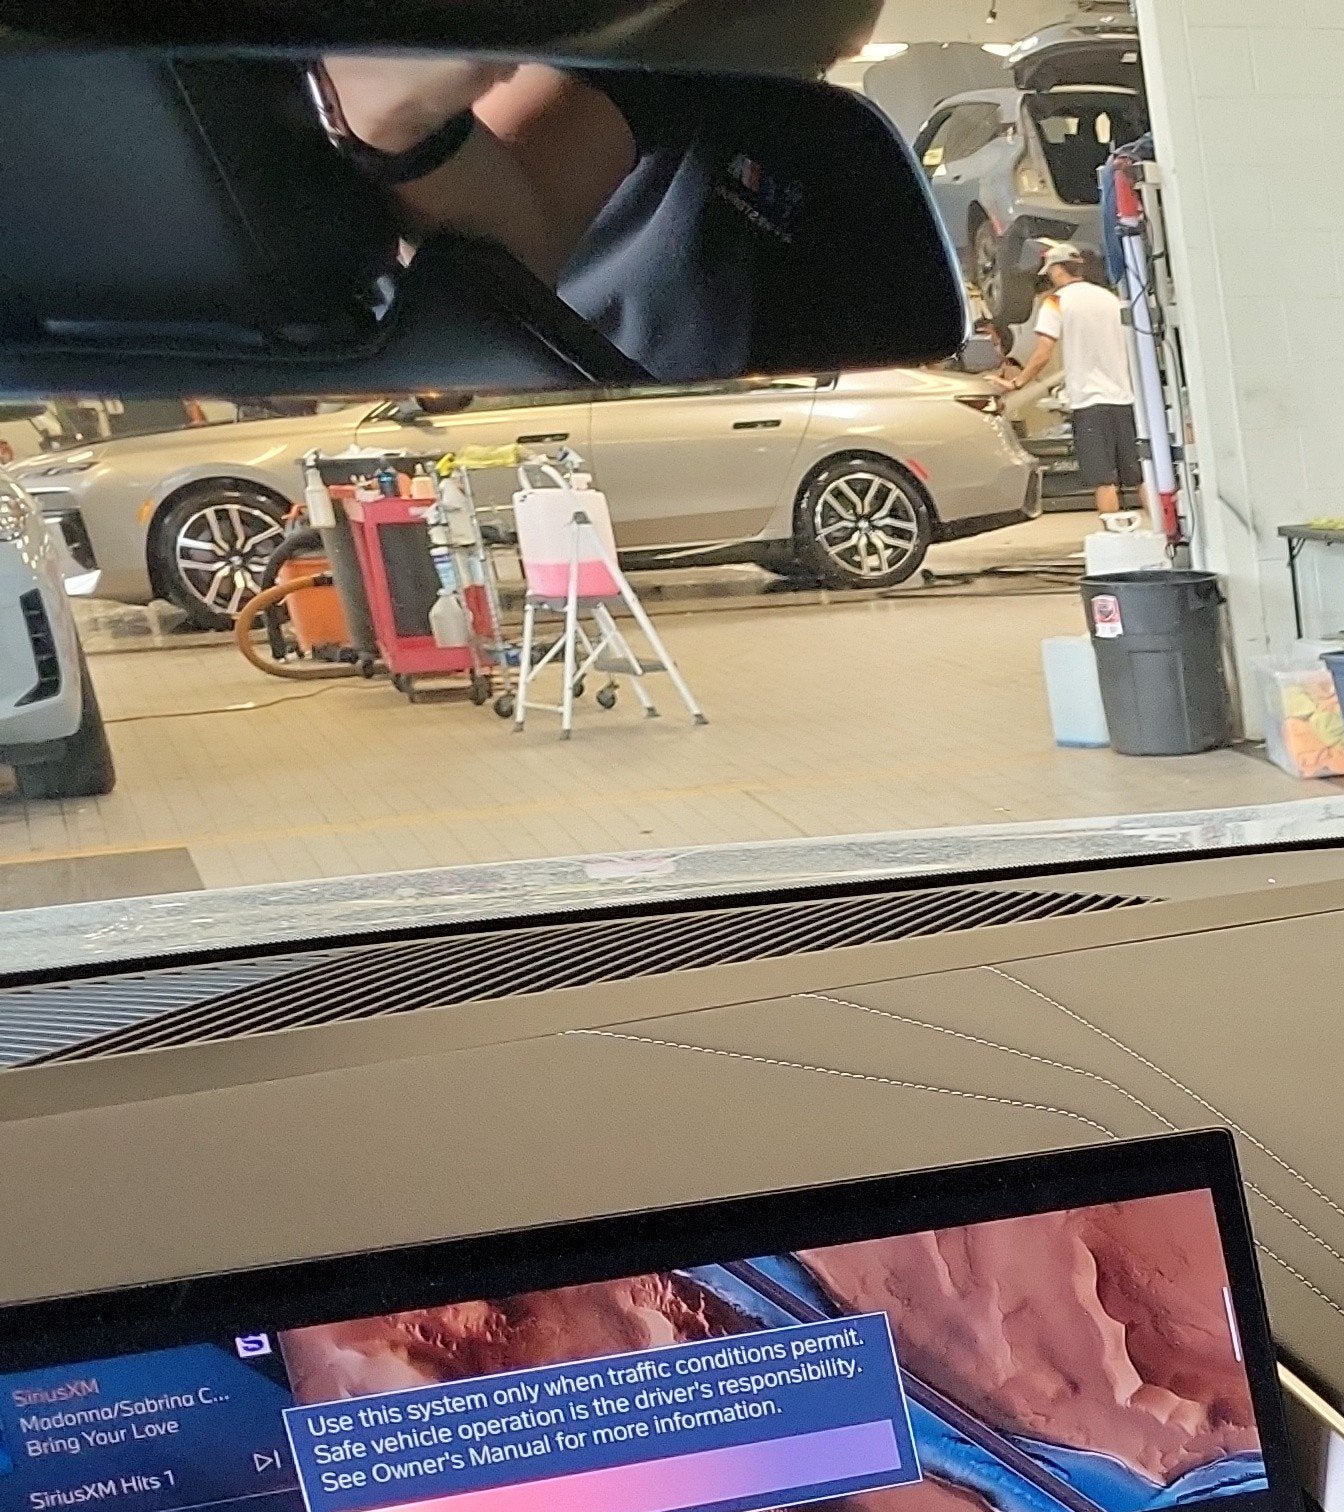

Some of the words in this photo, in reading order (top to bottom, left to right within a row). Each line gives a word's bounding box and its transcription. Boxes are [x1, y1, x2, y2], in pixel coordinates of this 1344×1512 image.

[12, 1378, 100, 1407] SiriusXM
[307, 1414, 353, 1437] Use
[358, 1404, 402, 1429] this
[406, 1391, 488, 1423] system
[493, 1381, 540, 1406] only
[543, 1373, 604, 1397] when
[607, 1361, 671, 1387] traffic
[675, 1343, 787, 1376] conditions
[790, 1327, 864, 1359] permit.
[20, 1391, 195, 1434] Madonna/Sabrina
[198, 1387, 230, 1405] C...
[313, 1441, 367, 1465] Safe
[371, 1423, 453, 1455] vehicle
[458, 1407, 565, 1442] operation
[569, 1401, 590, 1422] is
[592, 1394, 630, 1418] the
[634, 1380, 714, 1410] driver's
[718, 1357, 863, 1397] responsibility.
[26, 1435, 81, 1458] Bring
[82, 1427, 127, 1448] Your
[131, 1419, 180, 1440] Love
[321, 1471, 367, 1493] See
[371, 1451, 466, 1483] Owner's
[469, 1434, 552, 1468] Manual
[555, 1430, 588, 1452] for
[593, 1418, 650, 1446] more
[653, 1397, 783, 1434] information.
[30, 1480, 117, 1510] SiriusXM
[120, 1474, 161, 1494] Hits
[164, 1470, 176, 1486] 1
